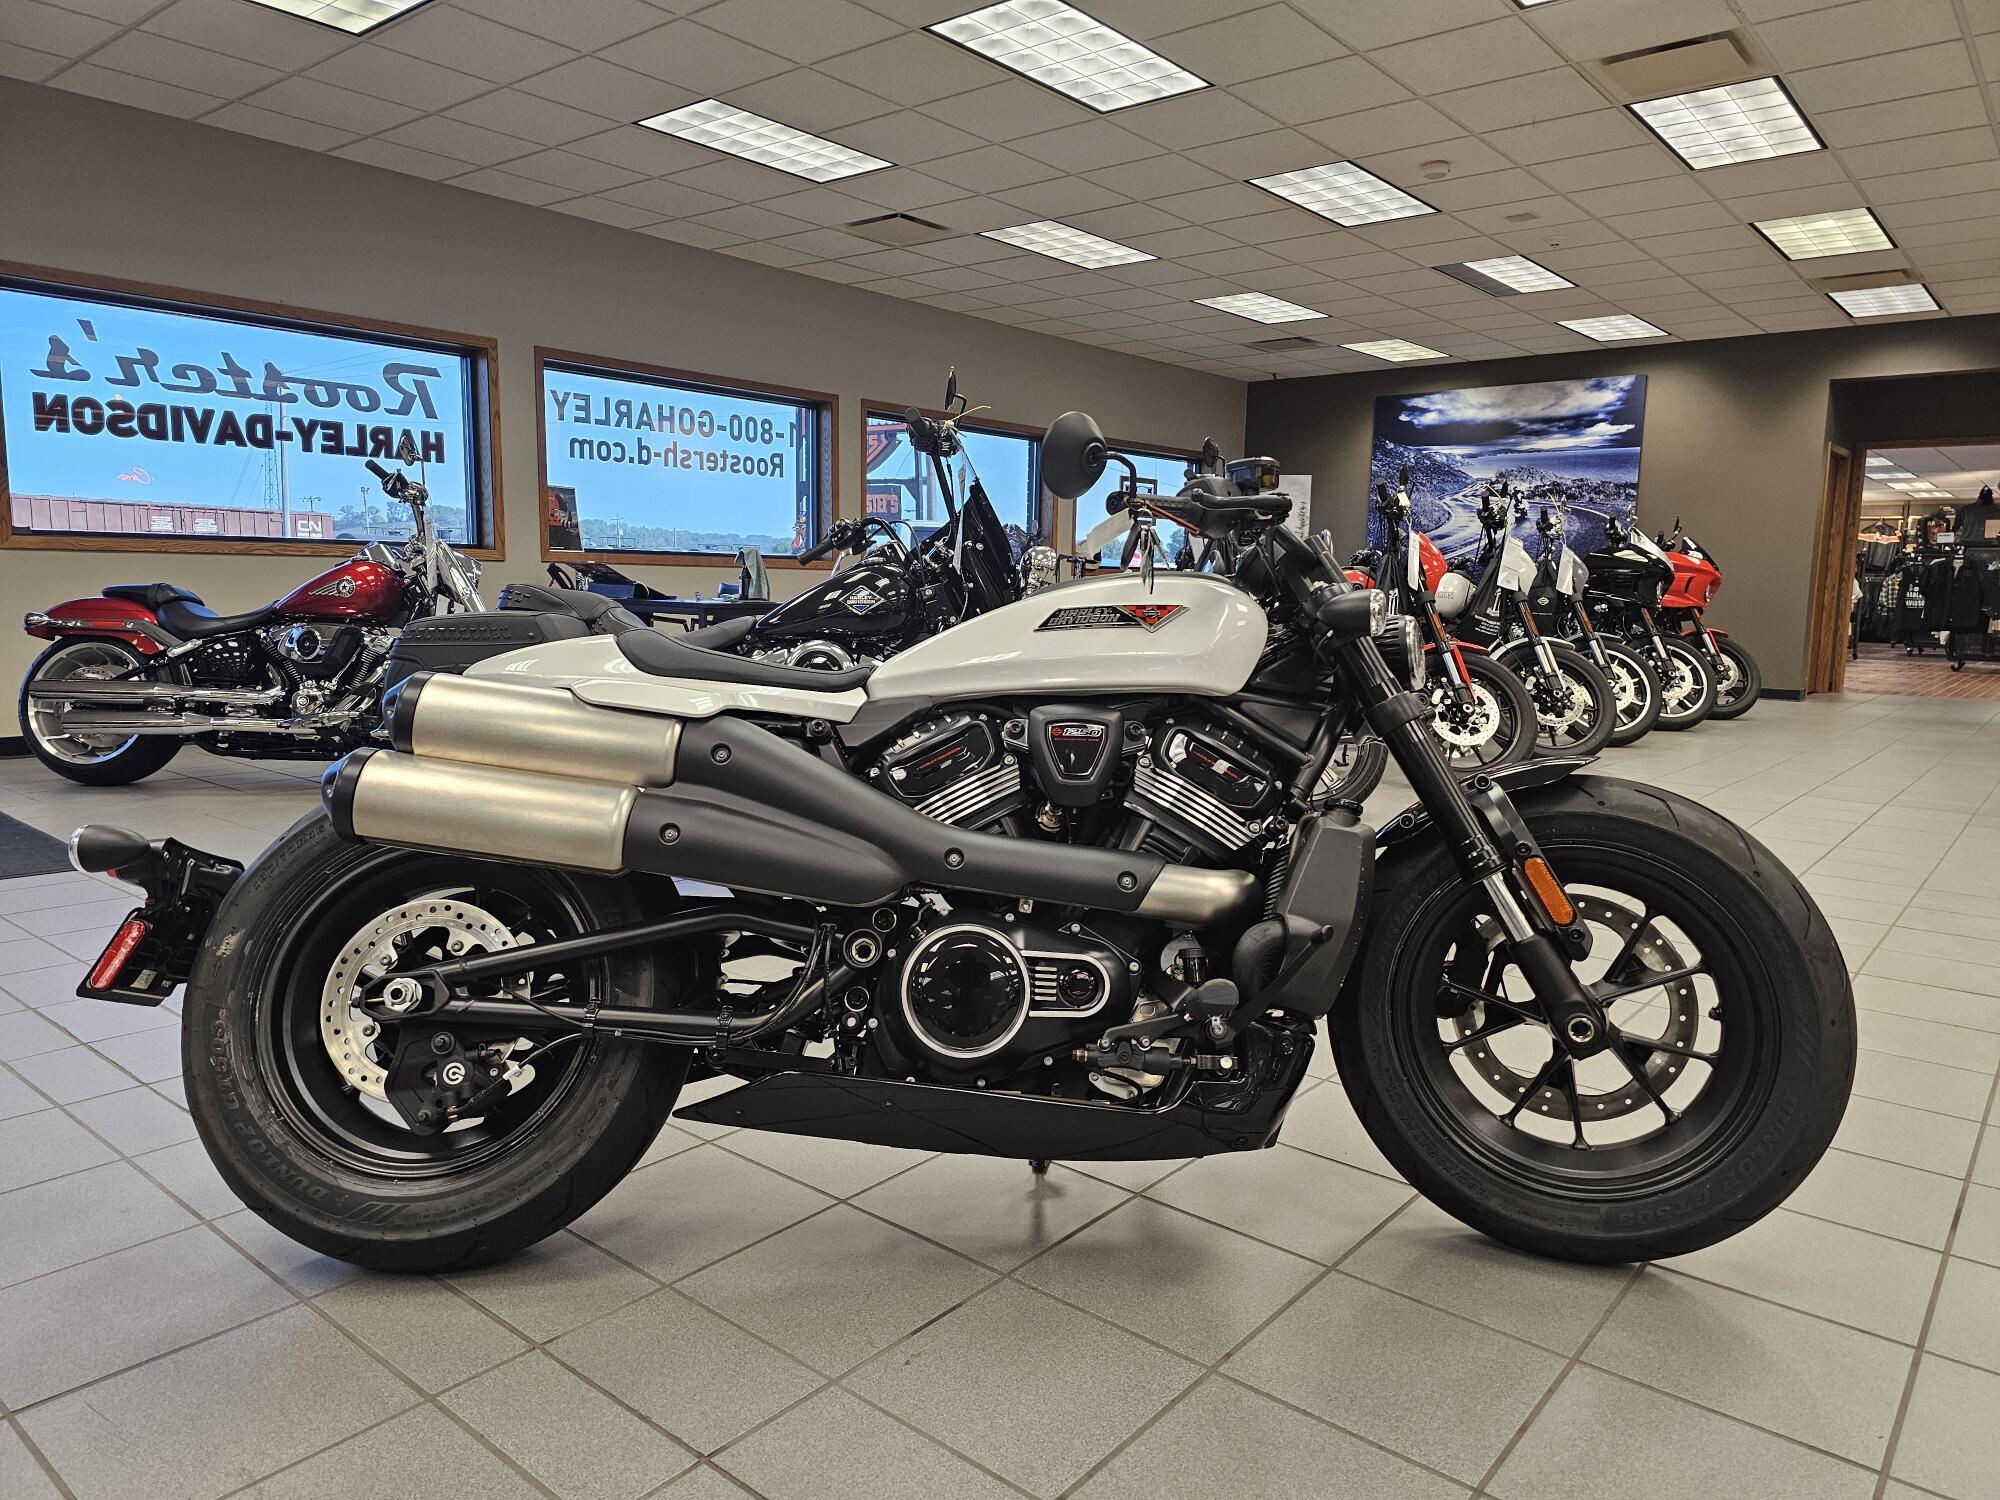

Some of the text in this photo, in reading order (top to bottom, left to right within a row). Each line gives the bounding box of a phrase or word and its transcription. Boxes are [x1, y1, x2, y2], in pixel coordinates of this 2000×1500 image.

[297, 520, 322, 532] CN
[1048, 614, 1120, 625] DAVIDSON
[1063, 728, 1101, 737] 1250
[234, 1121, 330, 1200] DUNLOP
